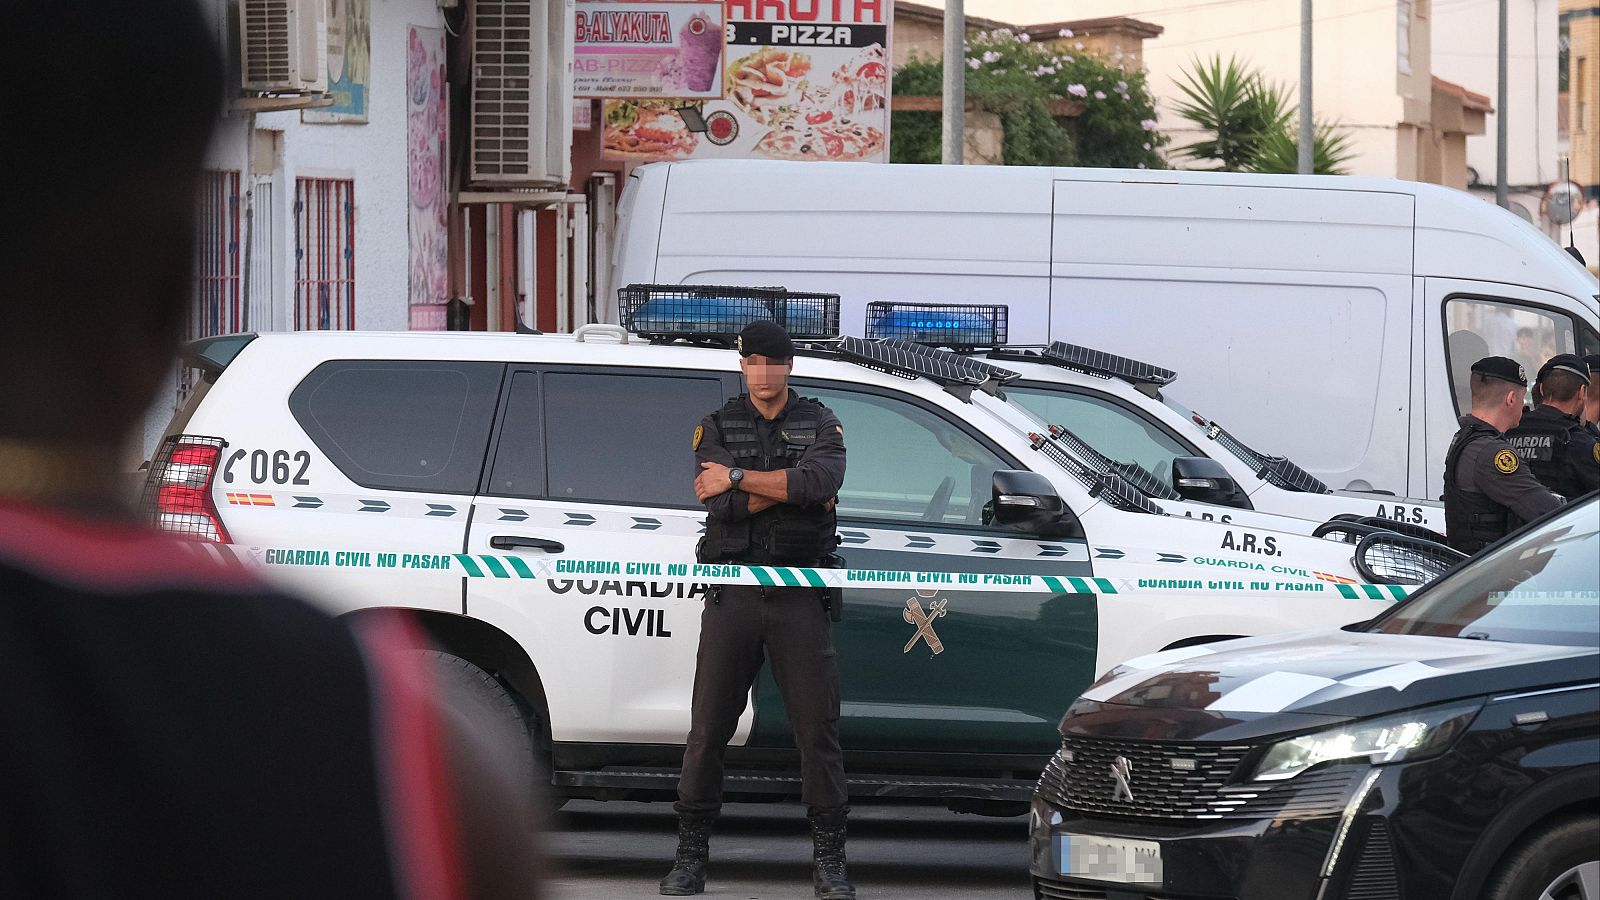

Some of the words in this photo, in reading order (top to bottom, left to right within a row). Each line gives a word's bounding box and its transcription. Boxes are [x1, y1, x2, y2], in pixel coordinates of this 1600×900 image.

[771, 25, 852, 45] PIZZA
[250, 449, 311, 485] 062
[1376, 504, 1428, 525] A.R.S.
[1221, 530, 1282, 557] A.R.S.
[265, 548, 330, 566] GUARDIA
[335, 551, 372, 567] CIVIL
[377, 553, 397, 568] NO
[402, 554, 451, 570] PASAR
[556, 559, 621, 575] GUARDIA
[626, 562, 662, 576] CIVIL
[667, 563, 687, 577] NO
[692, 564, 741, 578] PASAR
[1193, 556, 1265, 572] GUARDIA
[1271, 565, 1310, 578] CIVIL
[847, 570, 911, 582] GUARDIA
[916, 572, 953, 584] CIVIL
[584, 605, 672, 638] CIVIL
